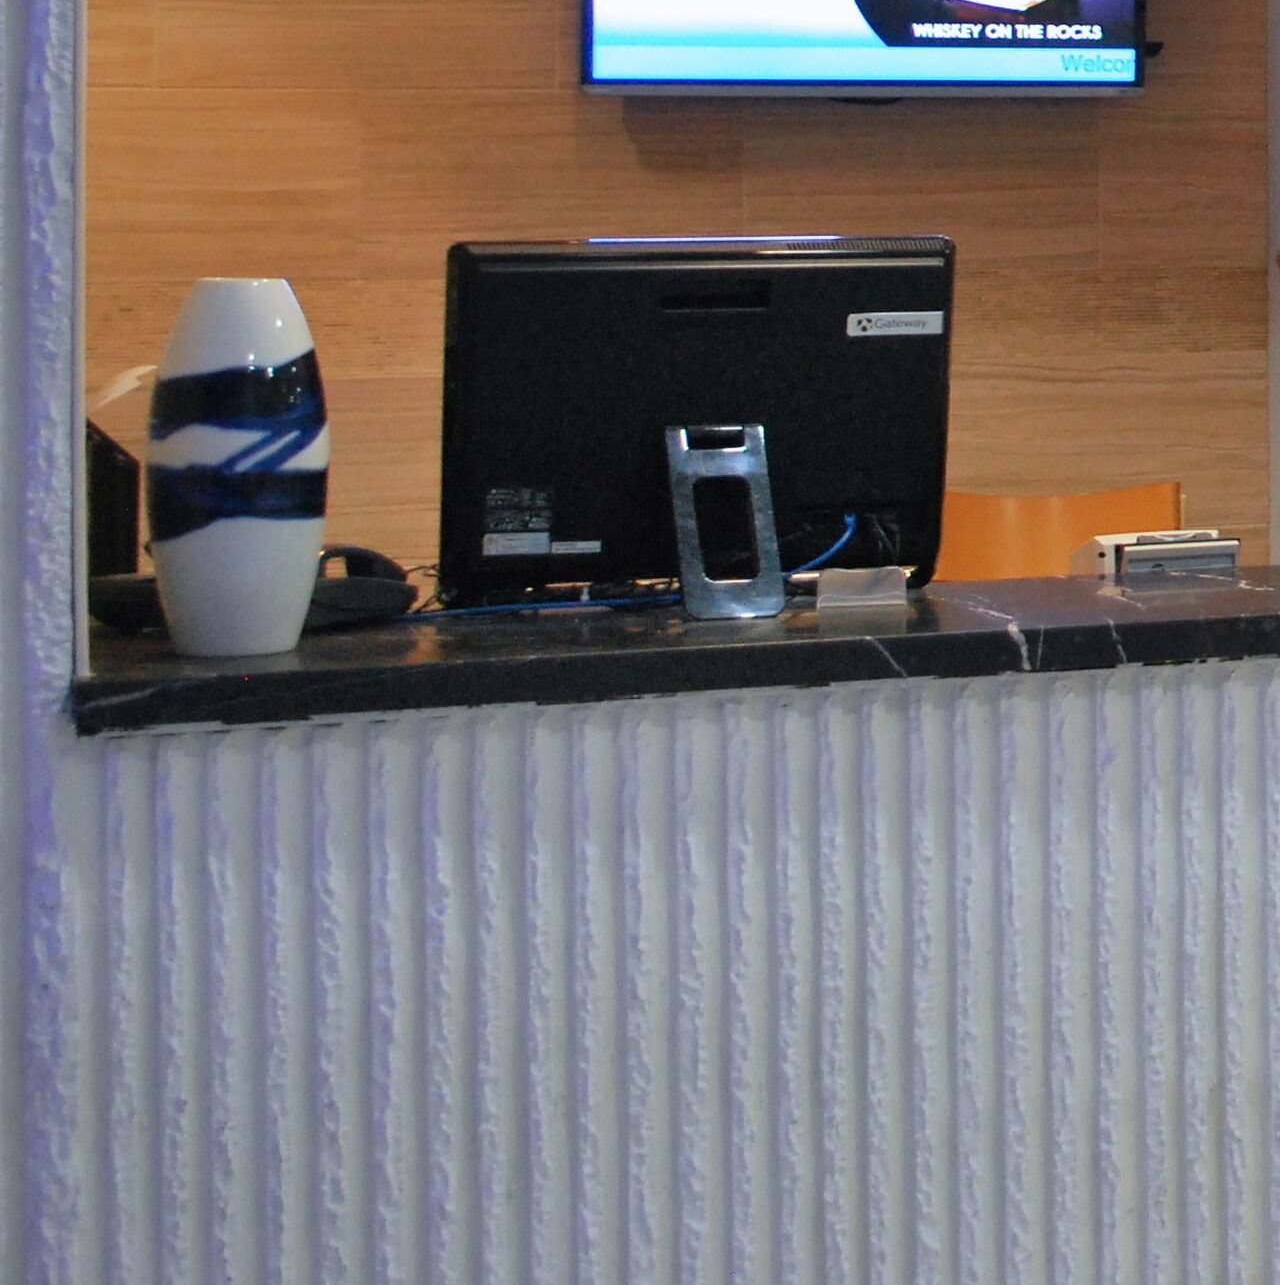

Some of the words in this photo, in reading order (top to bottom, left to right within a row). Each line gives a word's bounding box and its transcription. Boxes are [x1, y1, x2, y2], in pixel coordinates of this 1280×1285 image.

[911, 22, 983, 39] WHISKEY
[985, 23, 1013, 39] ON
[1014, 24, 1045, 40] THE
[1046, 24, 1103, 41] ROCKS
[874, 317, 929, 330] Gateway
